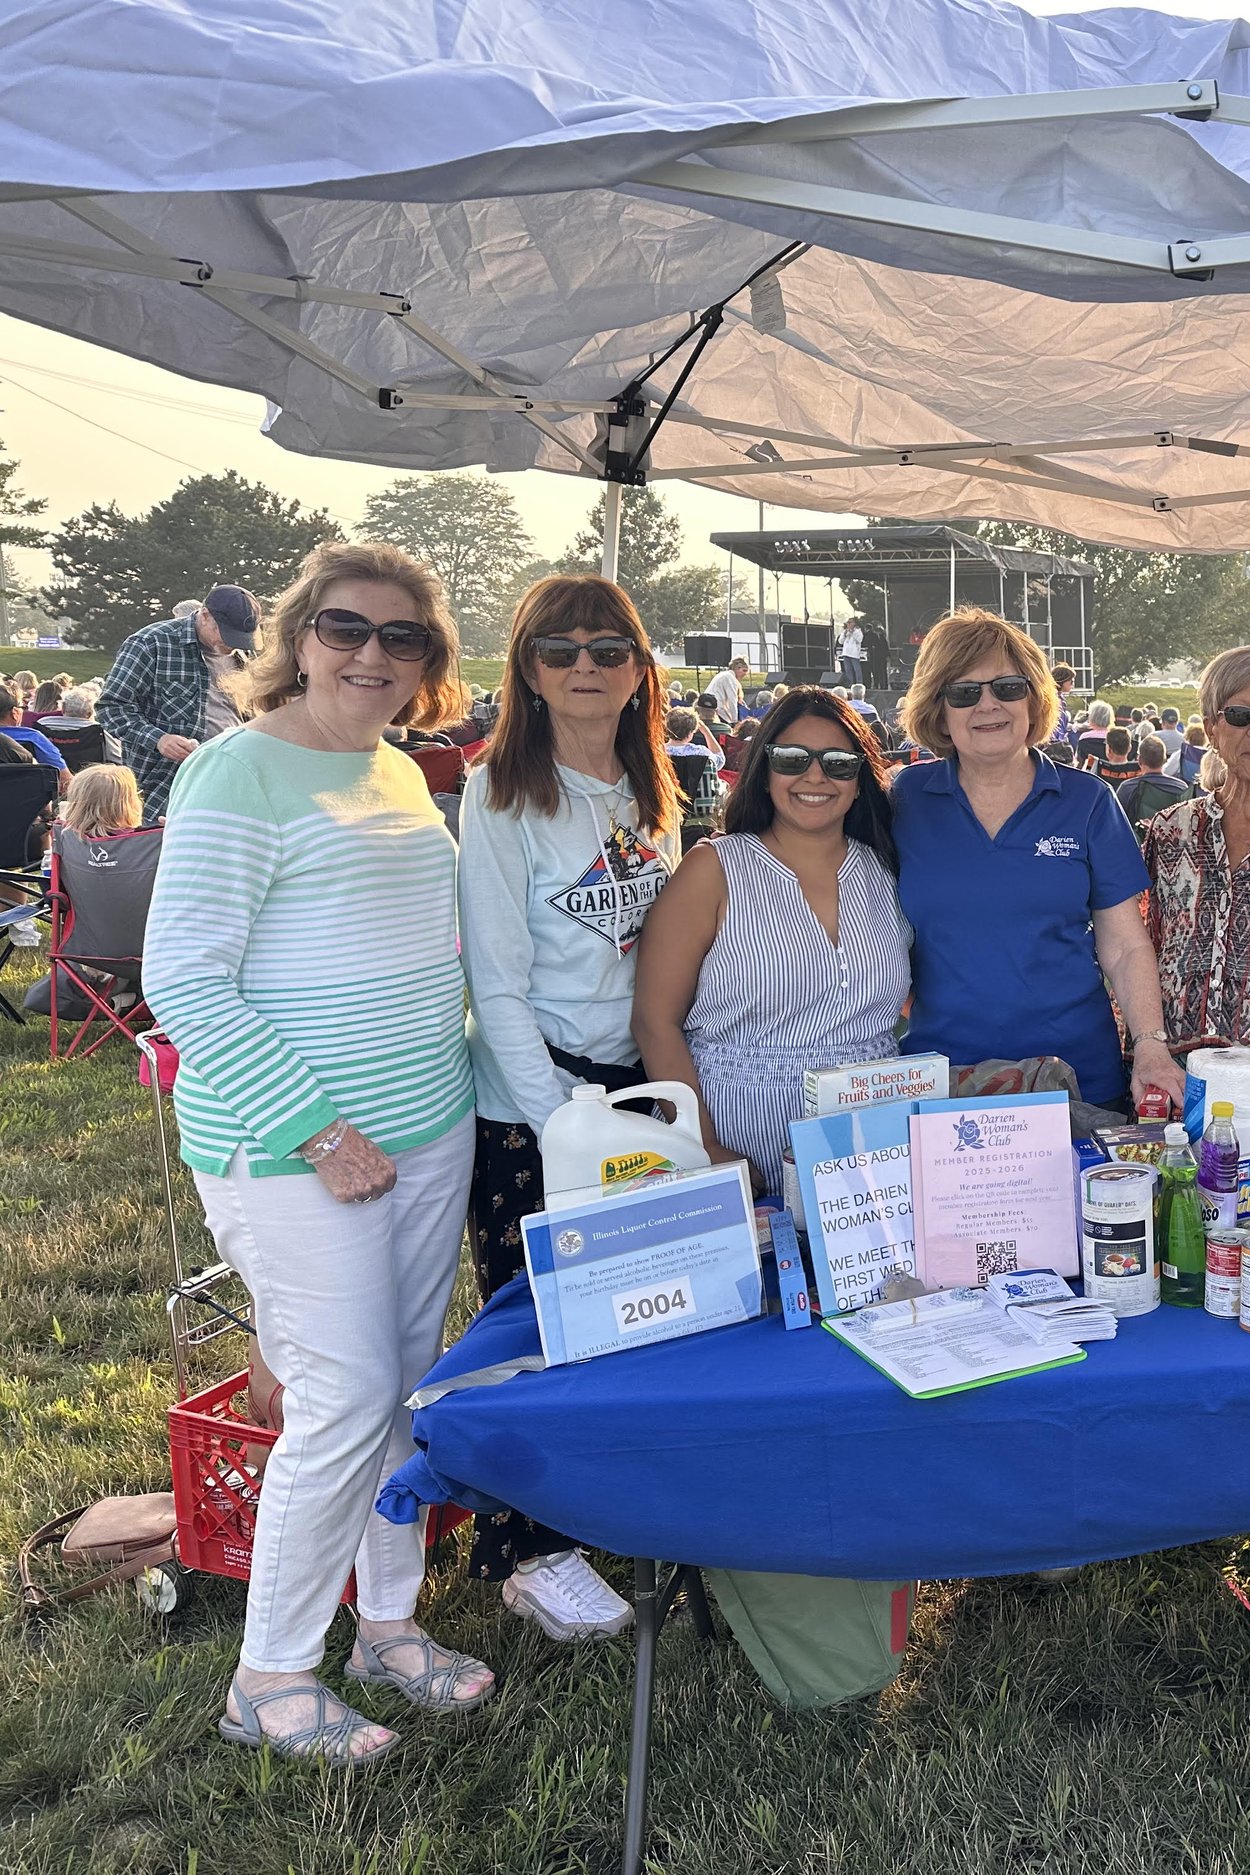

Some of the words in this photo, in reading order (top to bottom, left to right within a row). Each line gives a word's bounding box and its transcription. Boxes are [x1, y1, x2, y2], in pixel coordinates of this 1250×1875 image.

[639, 882, 651, 891] OF
[639, 891, 653, 900] THE
[598, 909, 648, 927] COLOR
[851, 1076, 868, 1090] Big
[871, 1072, 905, 1086] Cheers
[908, 1068, 922, 1080] for
[838, 1089, 870, 1104] Fruits
[872, 1086, 893, 1099] and
[896, 1078, 935, 1097] Veggies!
[978, 1112, 1015, 1124] Darien
[982, 1120, 1028, 1135] Woman's
[988, 1134, 1011, 1146] Club
[814, 1159, 844, 1176] ASK
[847, 1153, 868, 1169] US
[871, 1145, 911, 1164] ABOU
[934, 1156, 974, 1166] MEMBER
[980, 1150, 1053, 1162] REGISTRATION
[964, 1165, 1024, 1176] 2025-2026
[985, 1181, 1005, 1189] going
[1006, 1178, 1033, 1187] digital!
[819, 1196, 851, 1214] THE
[853, 1183, 908, 1207] DARIEN
[592, 1230, 619, 1240] Illinois
[621, 1223, 646, 1234] Liquor
[648, 1213, 677, 1227] Control
[678, 1204, 722, 1219] Commission
[823, 1206, 894, 1233] WOMAN'S
[897, 1202, 914, 1216] CL
[962, 1211, 1005, 1220] Membership
[599, 1263, 625, 1276] prepared
[651, 1250, 674, 1260] PROOF
[676, 1246, 686, 1254] OF
[829, 1255, 855, 1272] WE
[858, 1244, 898, 1265] MEET
[833, 1269, 876, 1292] FIRST
[1024, 1280, 1058, 1290] Woman's
[621, 1289, 687, 1324] 2004
[837, 1295, 857, 1311] OF
[588, 1340, 621, 1354] ILLEGAL
